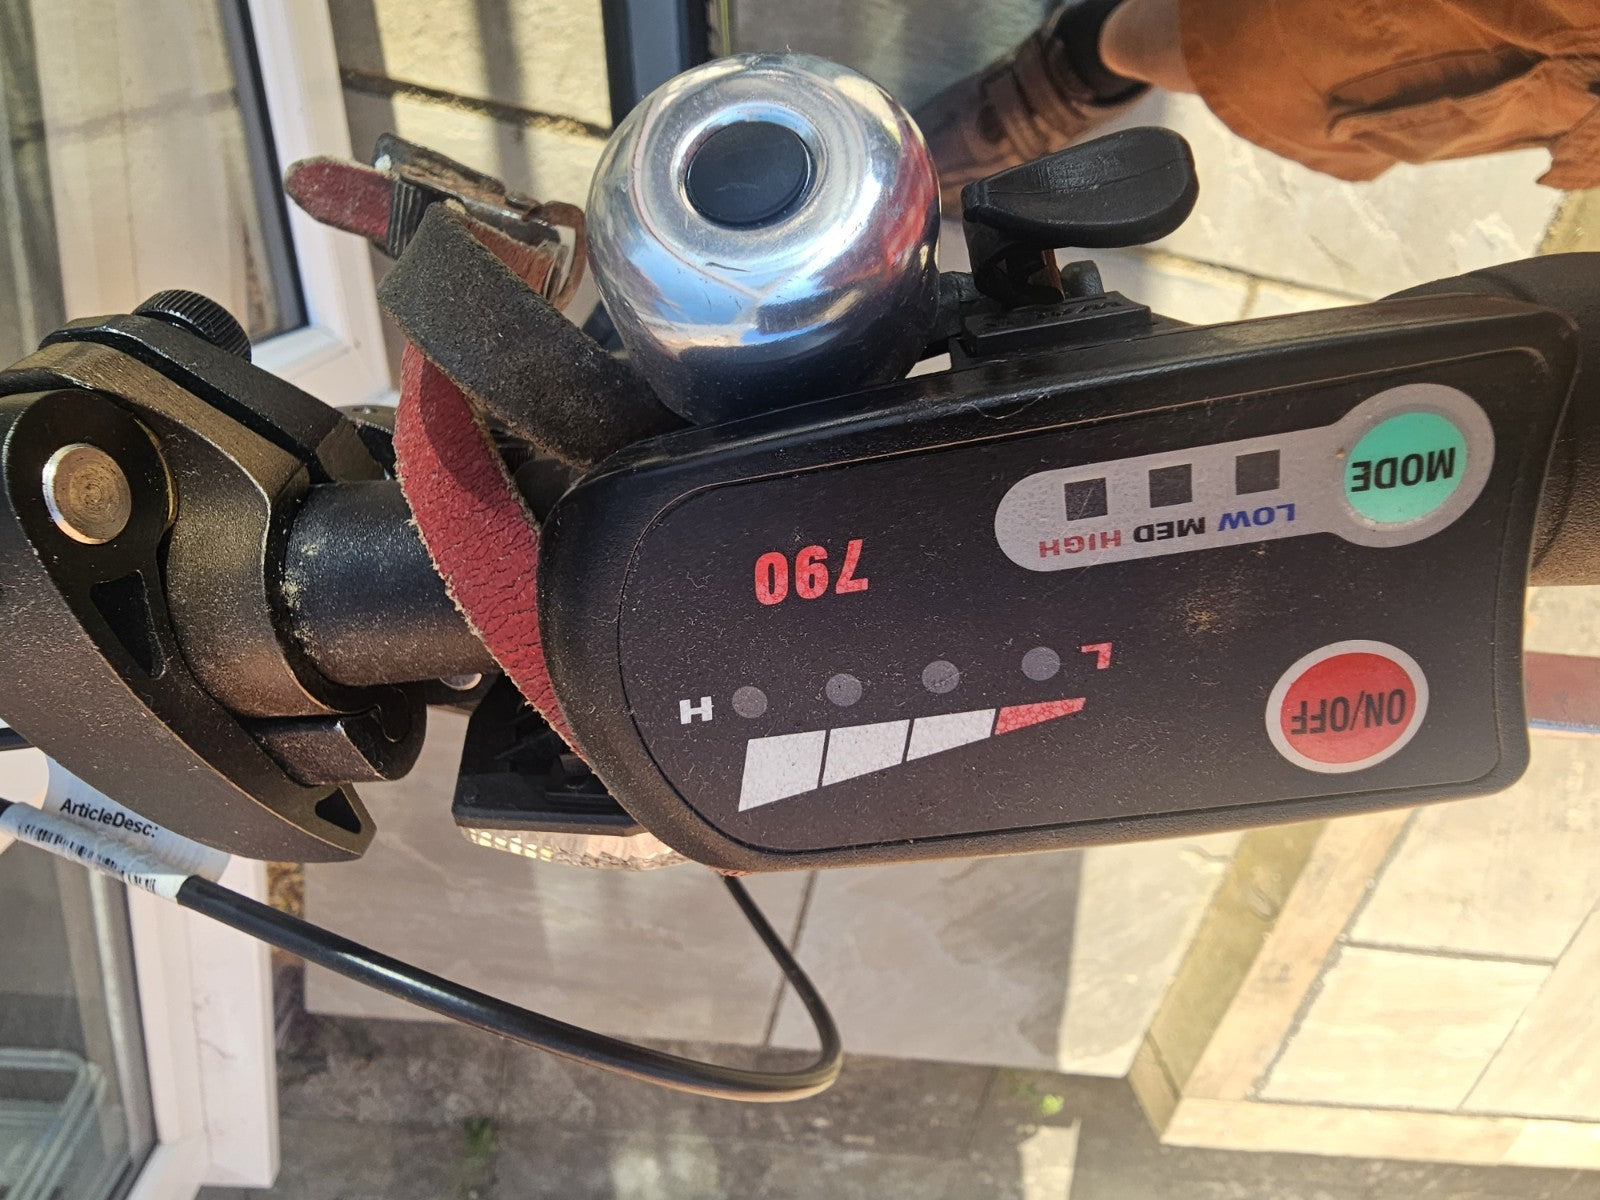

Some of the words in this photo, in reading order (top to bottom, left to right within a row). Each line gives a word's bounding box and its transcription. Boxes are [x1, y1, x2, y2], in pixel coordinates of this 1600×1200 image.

[1351, 447, 1456, 493] MODE
[1133, 516, 1206, 544] MED
[1217, 503, 1296, 532] LOW
[1038, 530, 1122, 559] HIGH
[754, 539, 869, 606] 790
[1081, 642, 1113, 670] L
[679, 696, 713, 725] H
[1290, 688, 1406, 735] ON/OFF
[60, 798, 159, 838] ArticleDesc:
